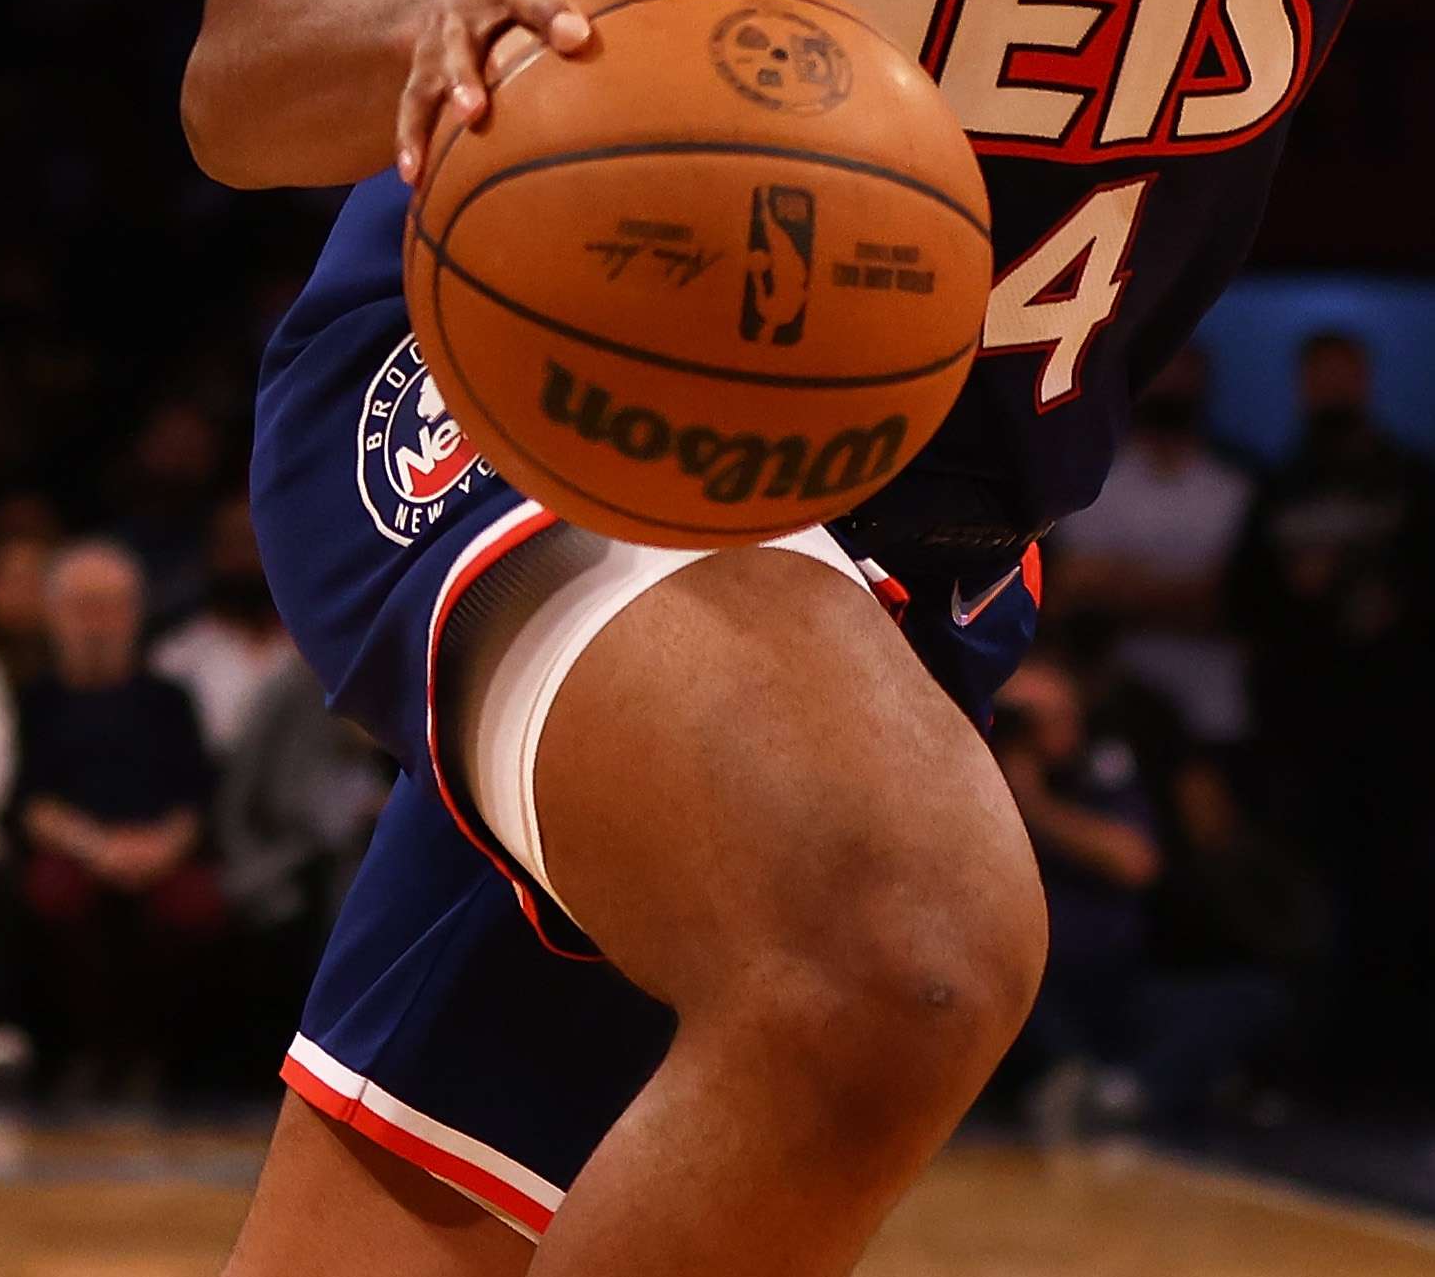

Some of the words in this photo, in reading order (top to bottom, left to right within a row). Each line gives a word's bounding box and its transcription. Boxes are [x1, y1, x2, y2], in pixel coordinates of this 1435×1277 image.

[366, 341, 426, 452] BROO
[539, 358, 911, 506] Wilson
[394, 418, 466, 497] Ne
[394, 499, 445, 534] NEW
